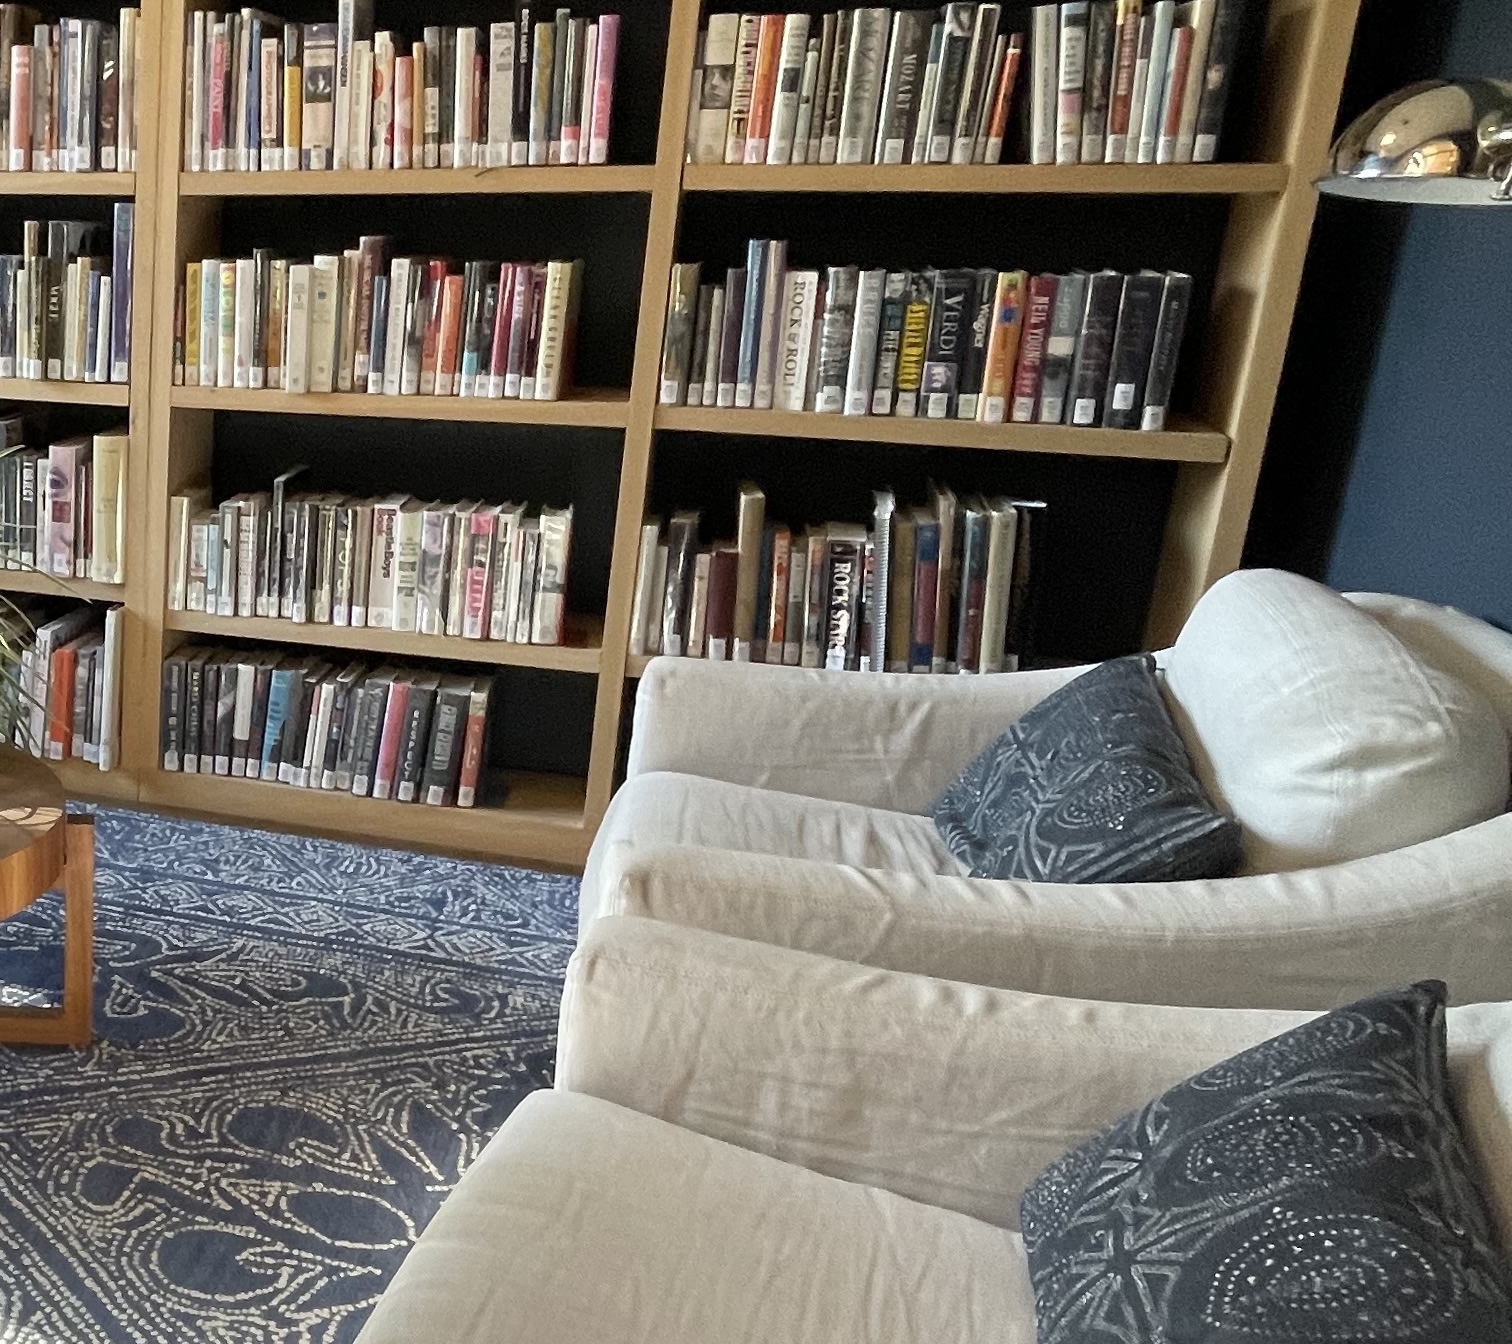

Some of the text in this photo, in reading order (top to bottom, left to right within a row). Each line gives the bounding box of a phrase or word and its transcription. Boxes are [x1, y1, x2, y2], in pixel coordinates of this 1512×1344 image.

[894, 54, 918, 110] MOZART
[790, 281, 807, 327] ROCK
[938, 292, 965, 355] VERDI
[973, 303, 990, 348] Wagner
[1030, 295, 1050, 325] NEIL
[1024, 326, 1046, 367] YOUNG
[382, 550, 394, 579] Boys
[831, 561, 852, 604] ROCK
[404, 710, 420, 780] RESPECT
